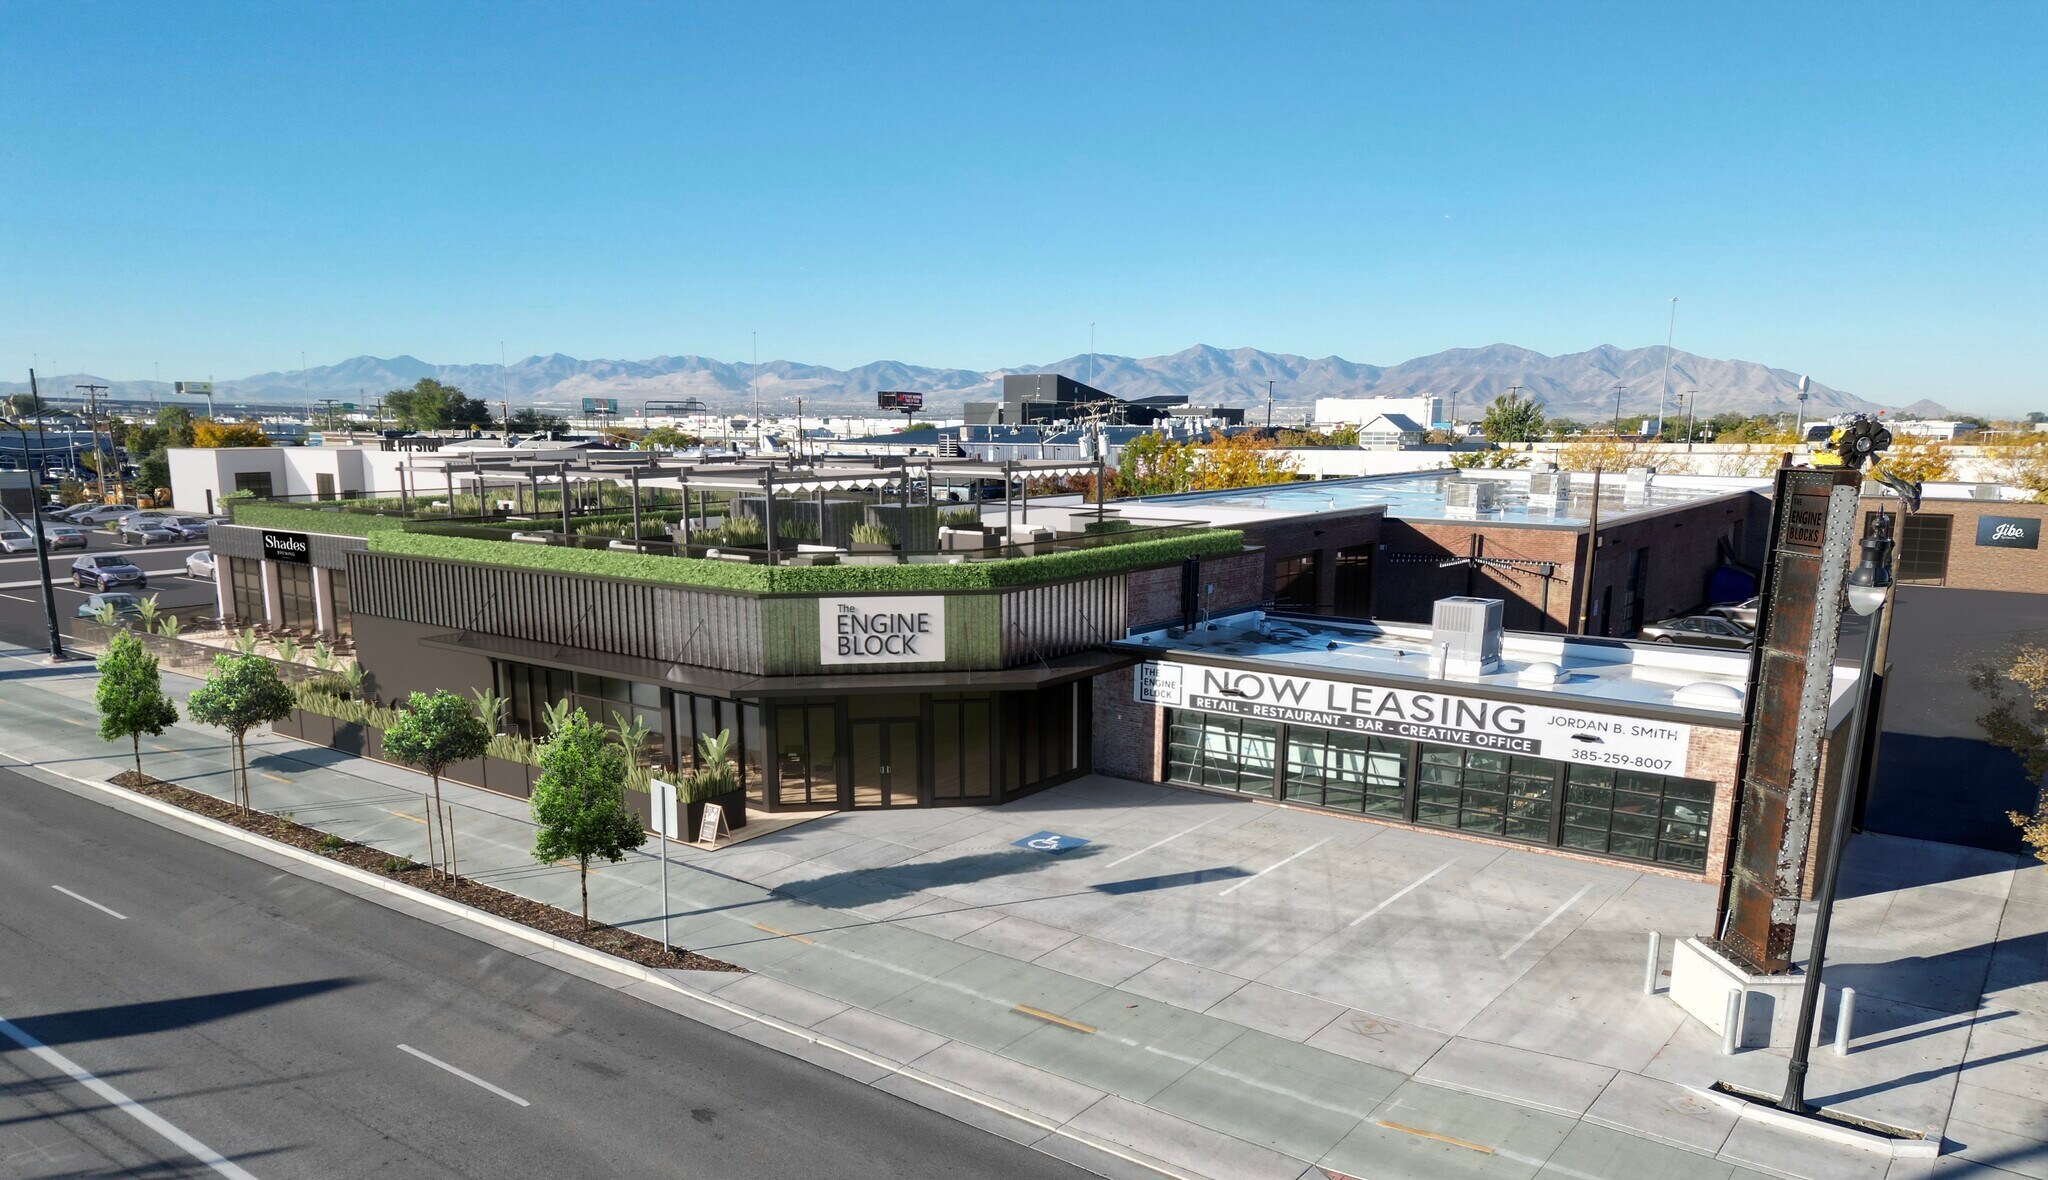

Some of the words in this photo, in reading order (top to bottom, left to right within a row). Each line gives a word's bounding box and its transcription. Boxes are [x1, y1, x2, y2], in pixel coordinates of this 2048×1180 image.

[379, 440, 396, 452] THE
[398, 440, 412, 452] PIT
[415, 440, 440, 452] STOP
[1793, 498, 1803, 506] THE
[1791, 510, 1822, 526] ENGINE
[1789, 527, 1819, 543] BLOCKS
[265, 535, 306, 552] Shades
[837, 604, 855, 613] The
[837, 613, 929, 635] ENGINE
[838, 634, 917, 656] BLOCK
[1144, 667, 1160, 677] THE
[1143, 678, 1176, 690] ENGINE
[1143, 688, 1172, 699] BLOCK
[1203, 669, 1311, 706] NOW
[1327, 684, 1526, 735] LEASING
[1196, 697, 1239, 713] RETAIL
[1253, 705, 1341, 726] RESTAURANT
[1355, 718, 1384, 732] BAR
[1399, 724, 1471, 744] CREATIVE
[1475, 734, 1532, 751] OFFICE
[1547, 715, 1609, 733] JORDAN
[1613, 723, 1626, 735] B.
[1631, 725, 1678, 742] SMITH
[1571, 749, 1672, 771] 385-259-8007
